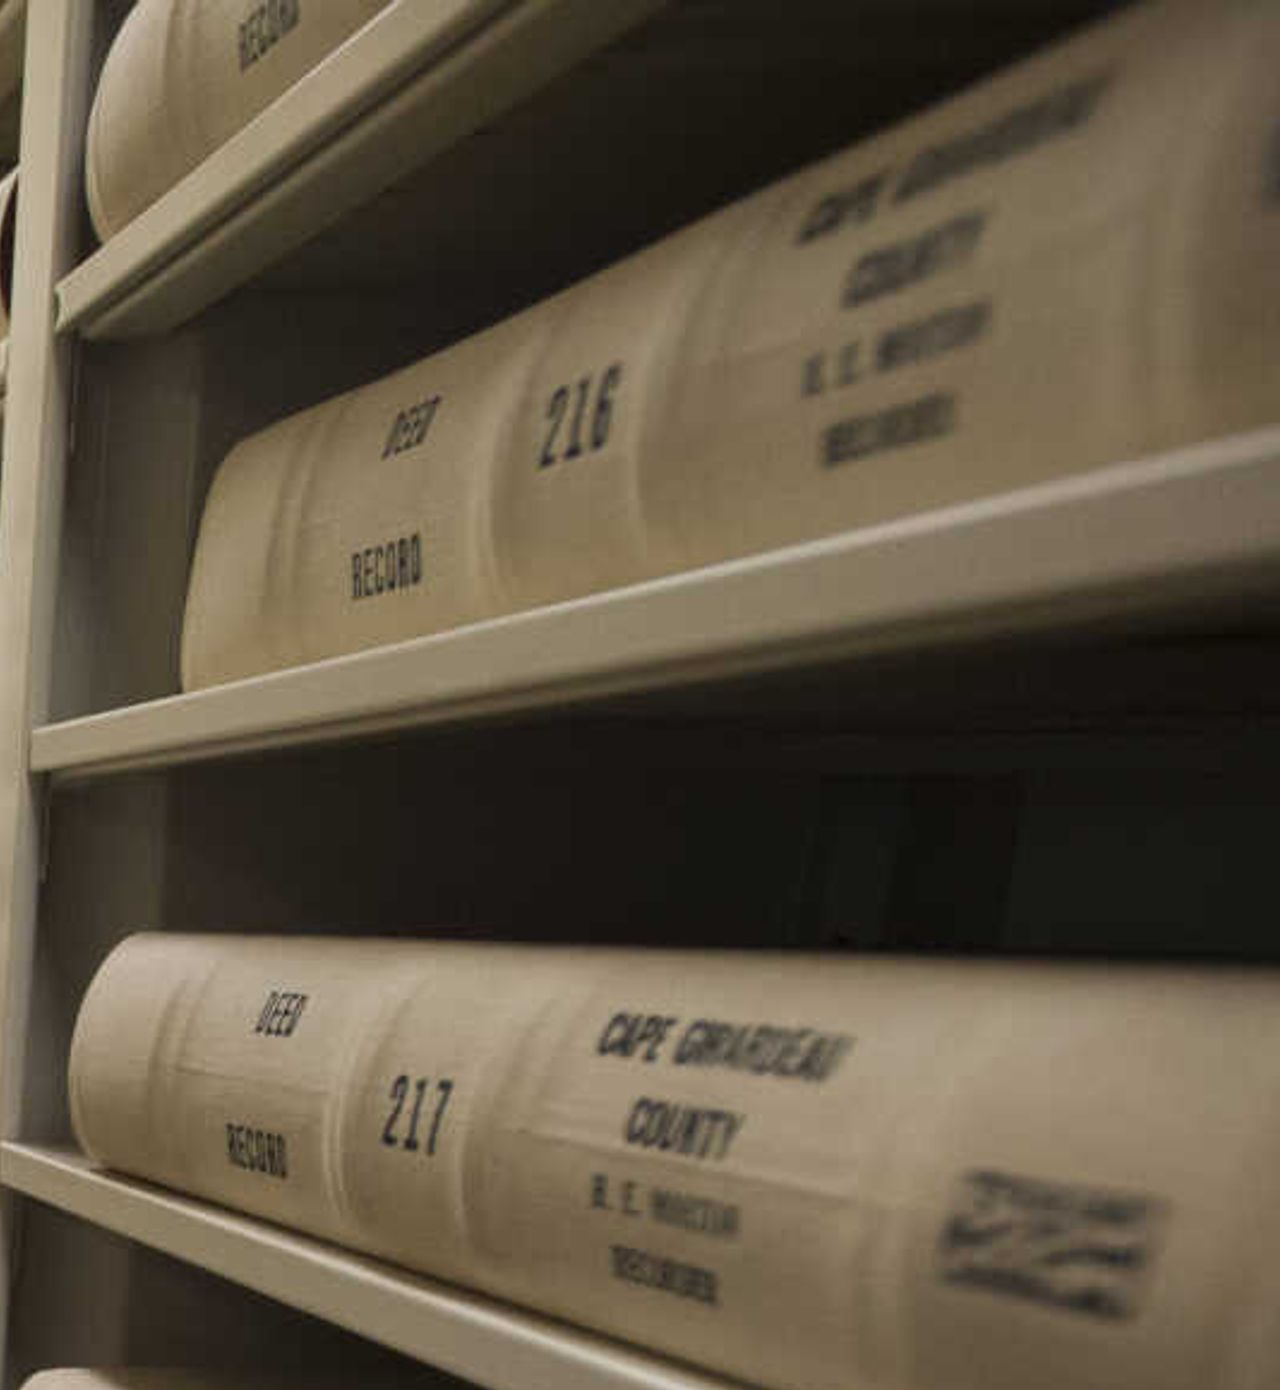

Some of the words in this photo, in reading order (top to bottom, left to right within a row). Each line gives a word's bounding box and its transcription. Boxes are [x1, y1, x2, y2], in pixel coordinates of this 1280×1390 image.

[380, 394, 441, 461] DEED
[537, 360, 624, 472] 216
[350, 531, 423, 602] RECORD
[254, 990, 309, 1038] DEED
[597, 1011, 677, 1066] CAPE
[673, 1018, 855, 1084] GIRARDEAU
[380, 1074, 454, 1157] 217
[625, 1096, 744, 1161] COUNTY
[226, 1123, 289, 1180] RECORD
